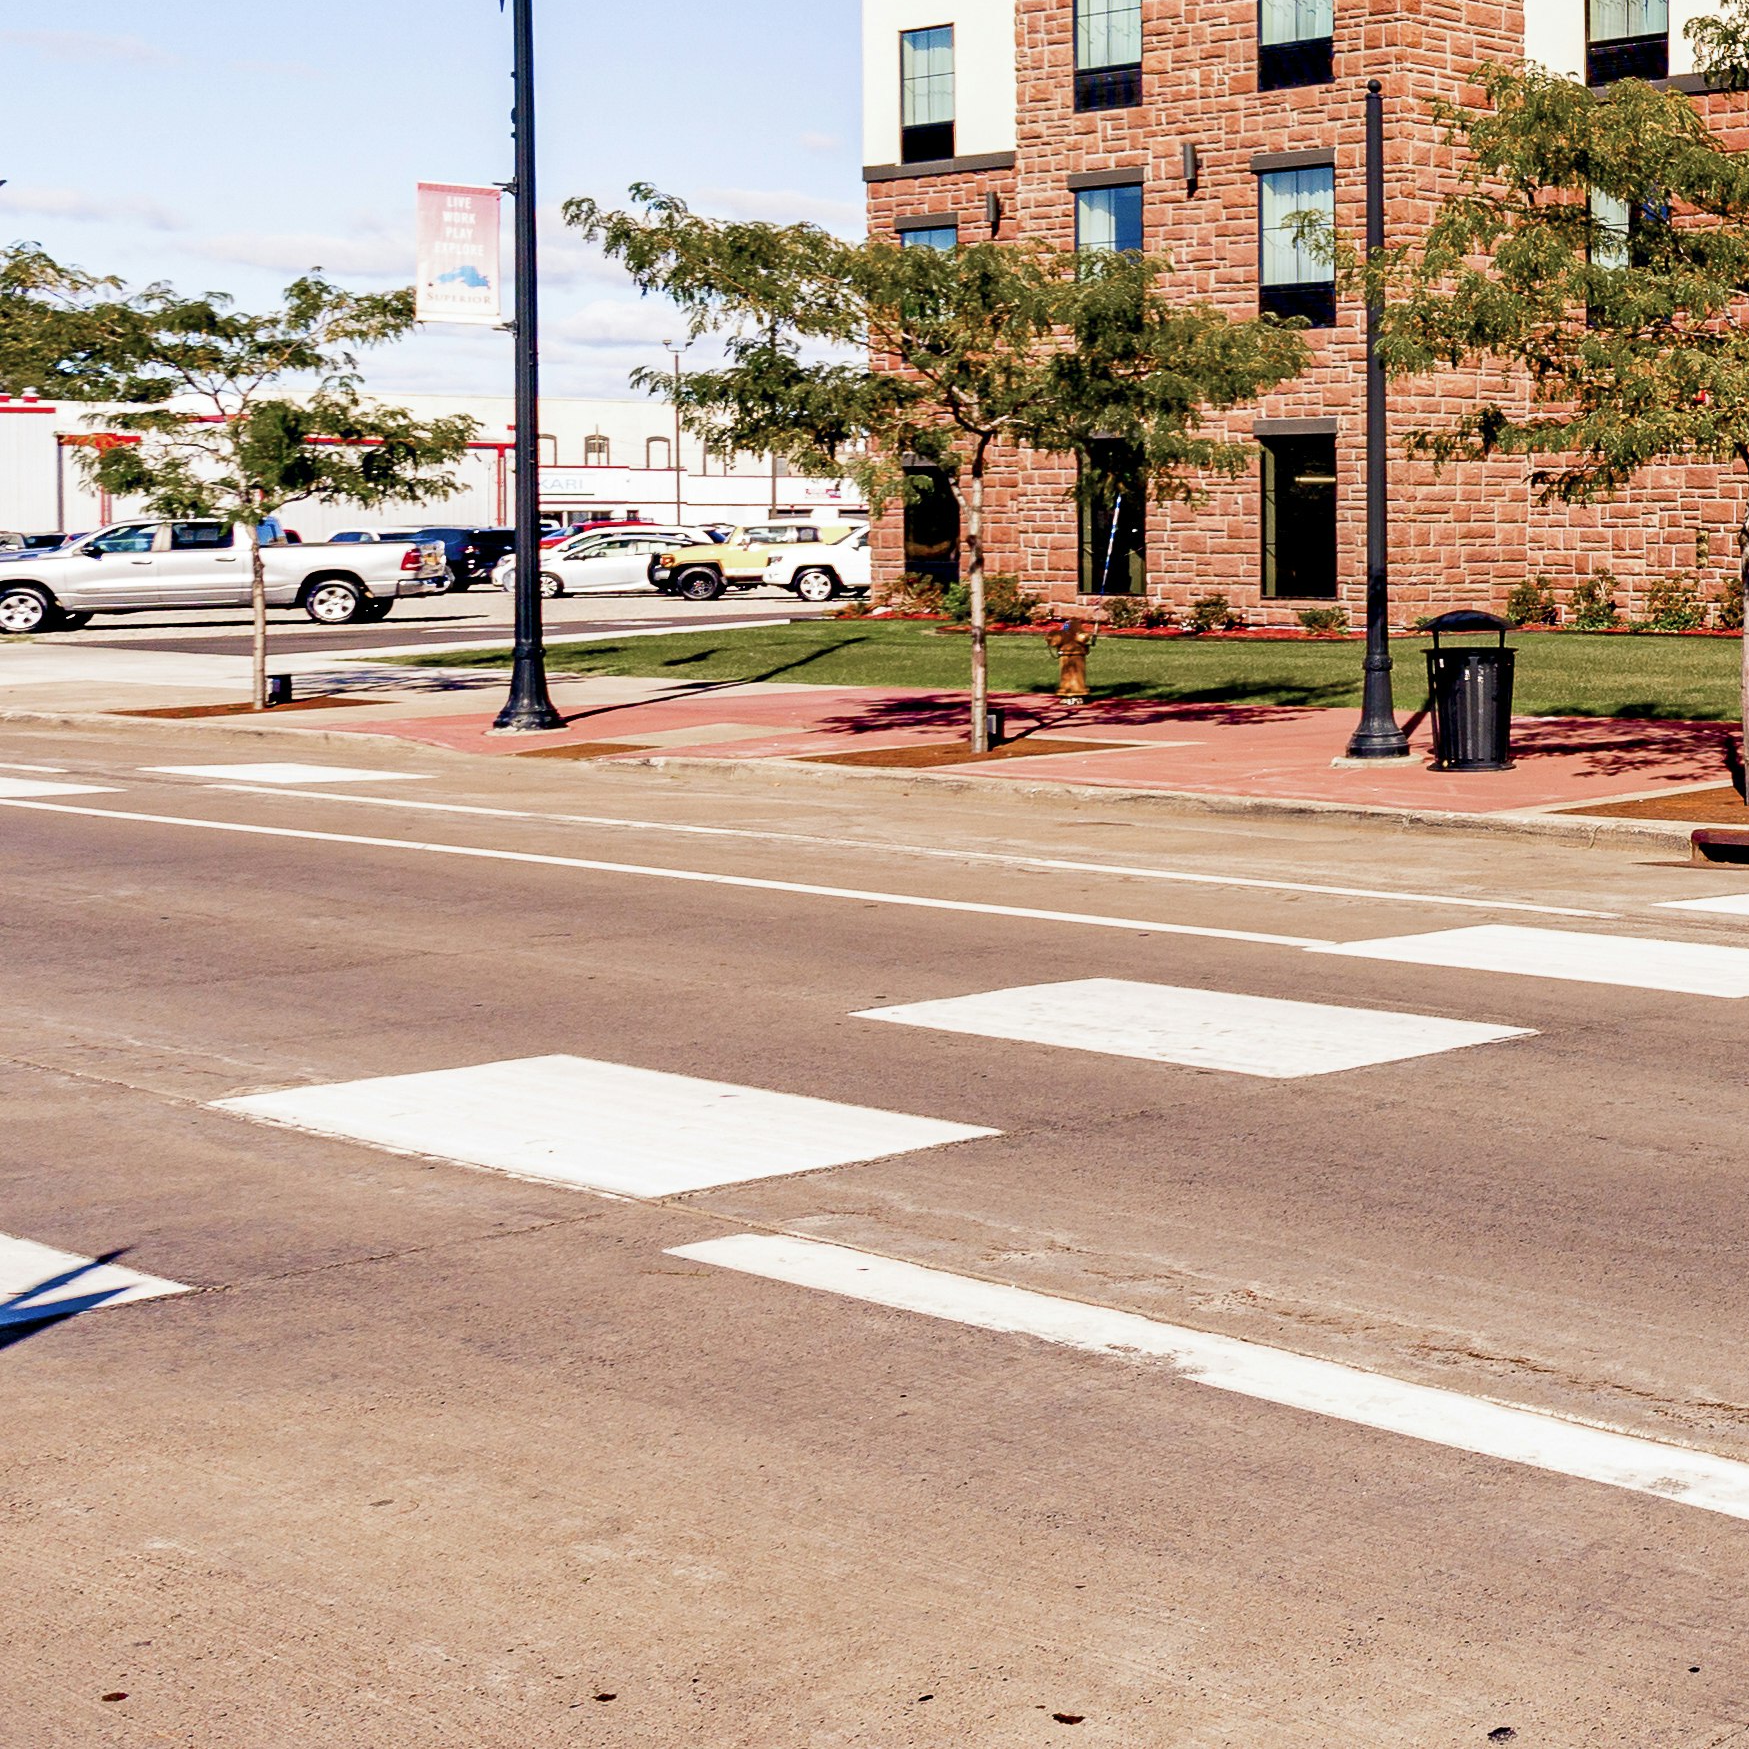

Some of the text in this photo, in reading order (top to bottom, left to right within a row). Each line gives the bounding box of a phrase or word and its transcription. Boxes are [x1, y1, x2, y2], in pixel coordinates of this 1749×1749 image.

[446, 195, 472, 209] LIVE
[442, 210, 476, 225] WORK
[445, 226, 474, 239] PLAY
[433, 241, 484, 257] EXPLORE
